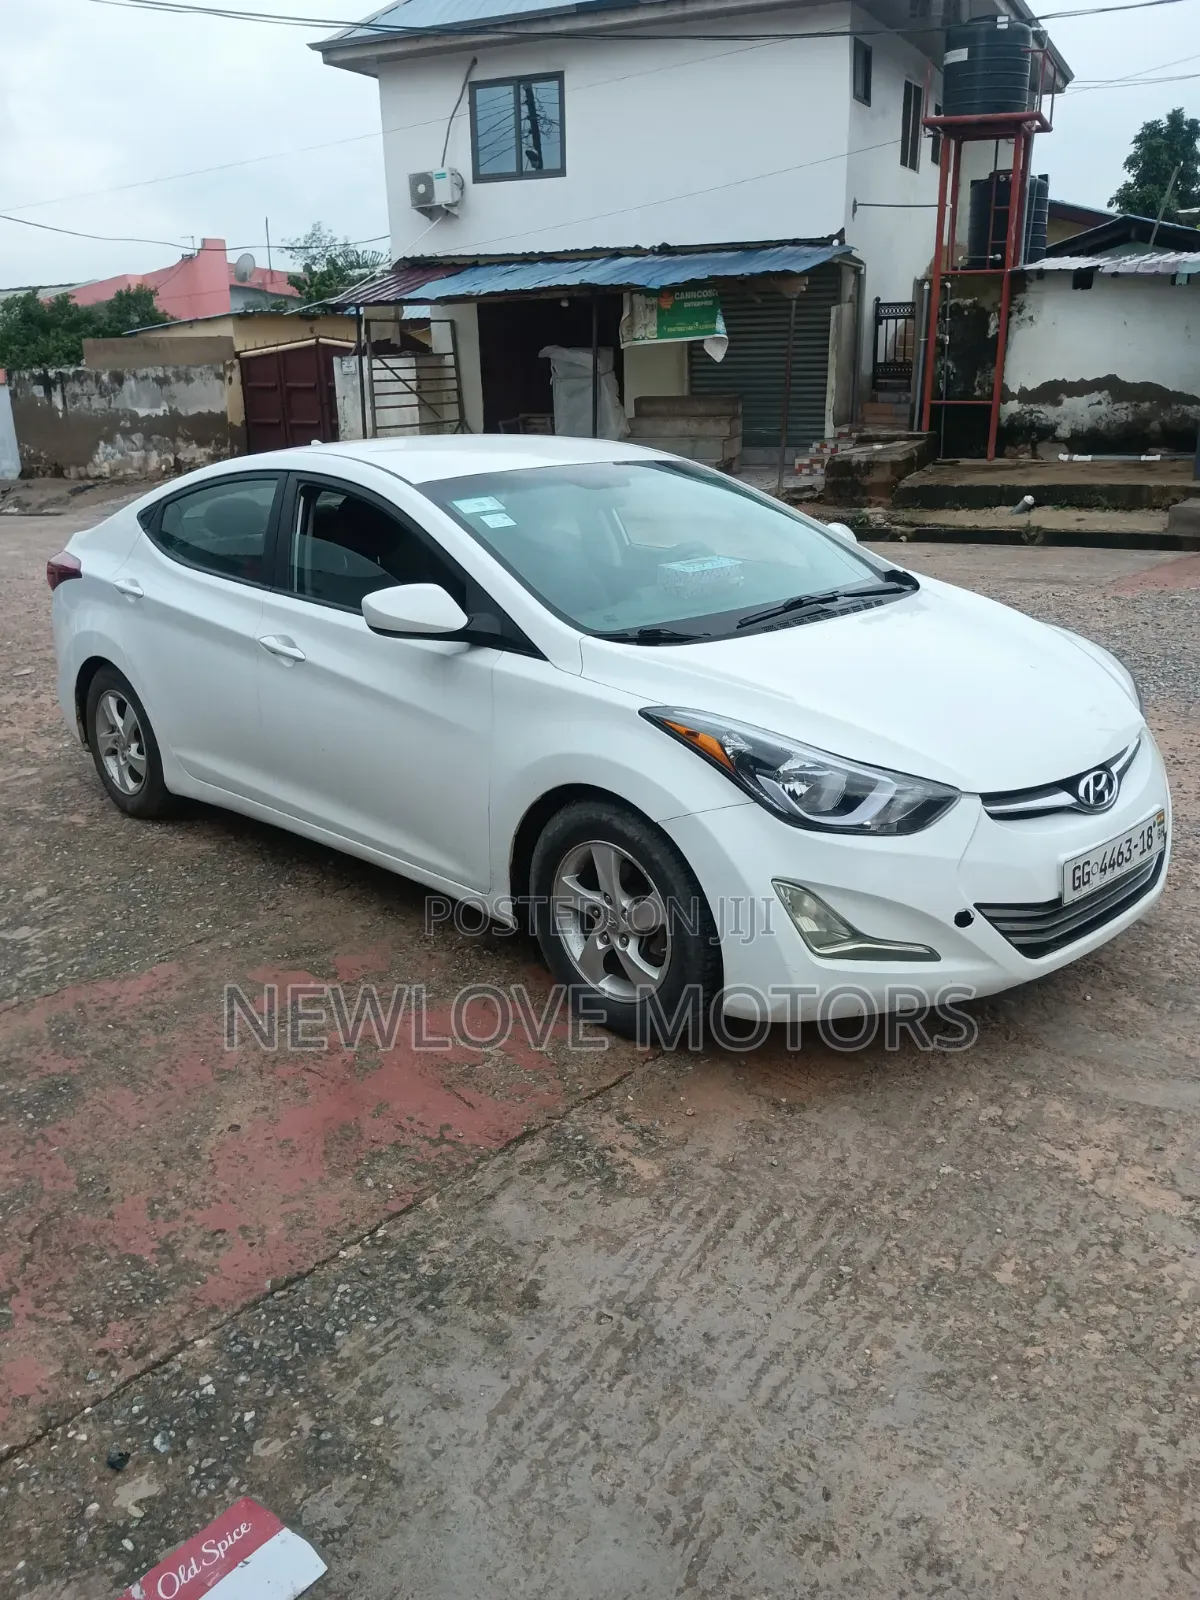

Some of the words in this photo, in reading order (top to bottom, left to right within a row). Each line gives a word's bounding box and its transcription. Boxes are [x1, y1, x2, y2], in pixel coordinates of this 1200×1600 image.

[1072, 859, 1091, 892] GG
[1099, 824, 1154, 876] 4463-18
[157, 1556, 202, 1600] Old
[201, 1521, 252, 1567] Spice
